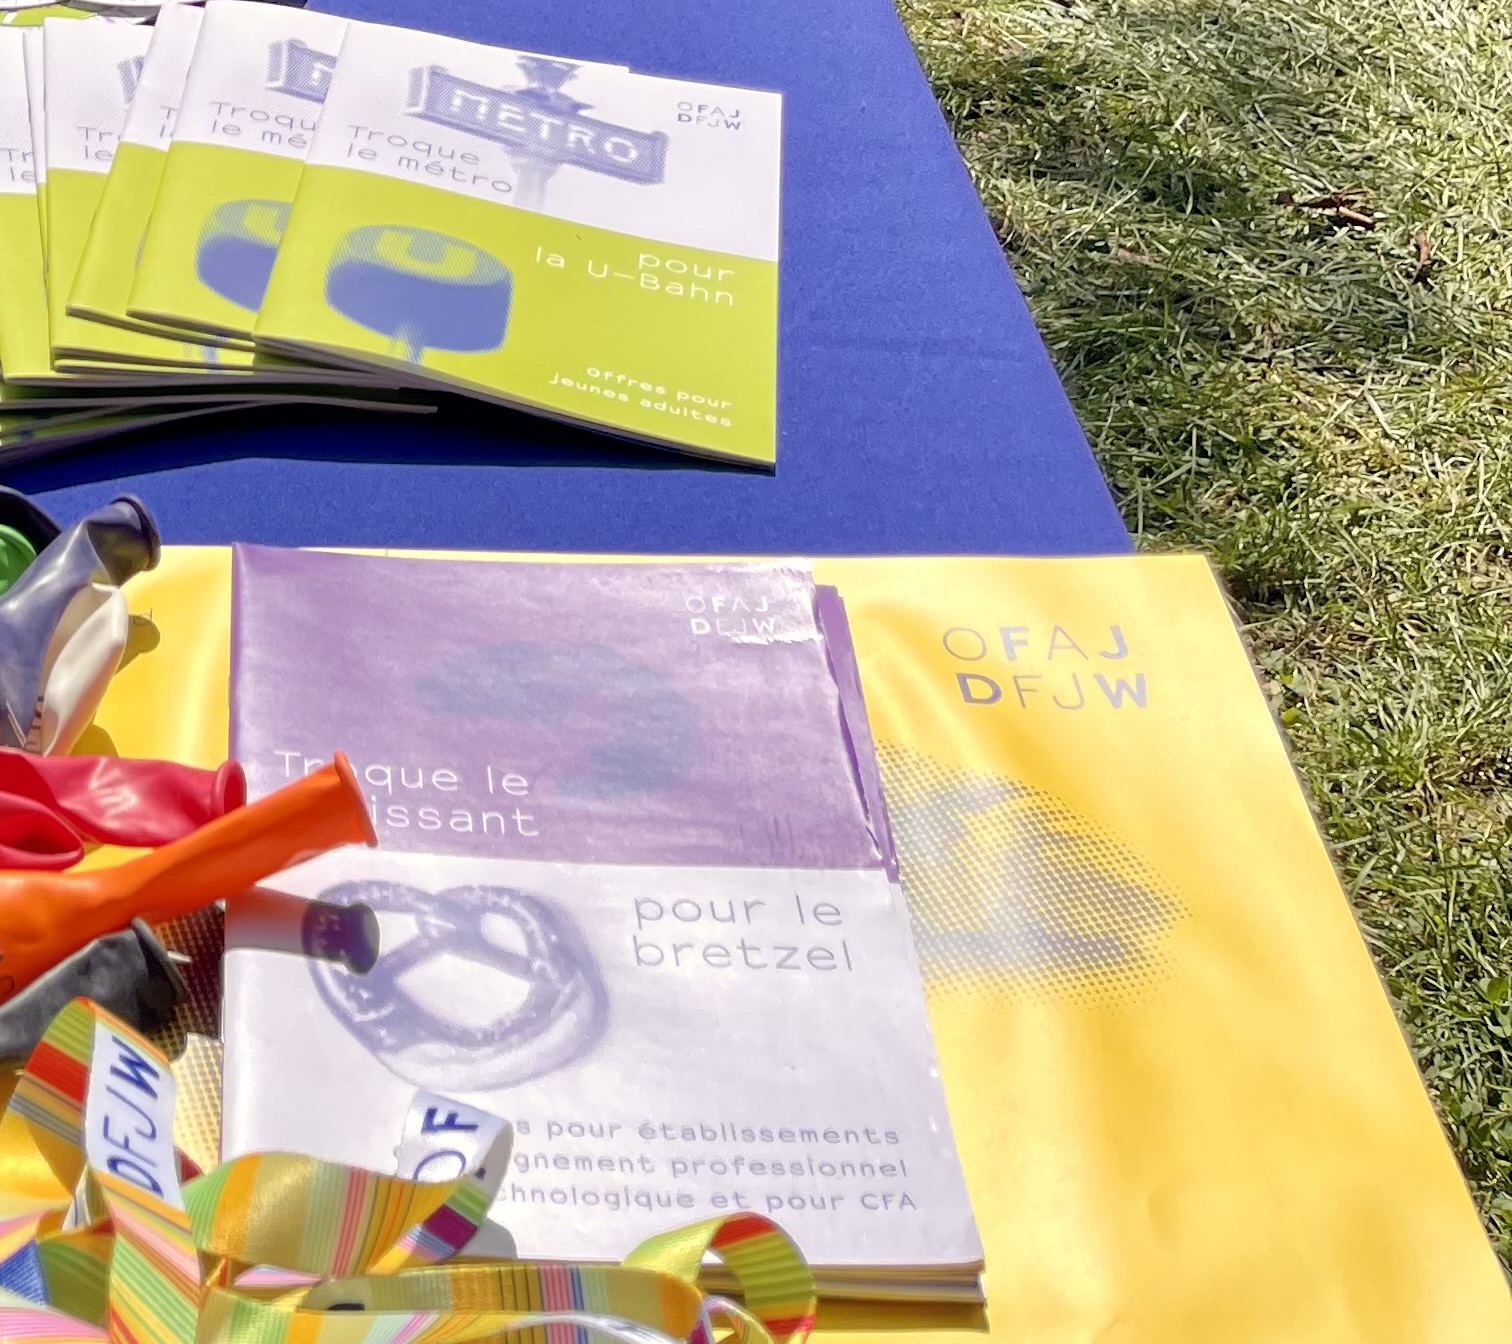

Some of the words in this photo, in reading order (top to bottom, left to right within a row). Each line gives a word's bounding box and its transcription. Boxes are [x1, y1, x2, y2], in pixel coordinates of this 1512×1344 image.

[210, 100, 316, 132] Troqu
[212, 119, 241, 136] le
[677, 101, 741, 119] OFAJ
[677, 113, 742, 130] DFJW
[347, 123, 482, 167] Troque
[346, 141, 378, 164] le
[397, 153, 514, 195] métro
[535, 246, 566, 270] la
[587, 258, 735, 307] U-Bahn
[639, 250, 736, 283] pour
[548, 372, 629, 403] jeunes
[640, 398, 732, 427] adultes
[676, 390, 733, 409] pour
[685, 594, 770, 613] OFAJ
[942, 625, 1130, 661] OFAJ
[956, 672, 1148, 709] DFJW
[273, 749, 458, 796] Trque
[486, 765, 529, 796] le
[370, 794, 539, 837] issant
[633, 894, 766, 929] pour
[796, 894, 843, 926] le
[633, 933, 852, 972] bretzel
[103, 1035, 163, 1198] DFJW
[547, 1118, 622, 1141] pour
[638, 1117, 900, 1145] établissements
[414, 1106, 480, 1182] OF
[514, 1152, 656, 1175] gnement
[671, 1154, 908, 1178] professionnel
[496, 1182, 695, 1210] chnologique
[711, 1190, 751, 1209] et
[766, 1190, 843, 1213] pour
[861, 1192, 917, 1211] CFA
